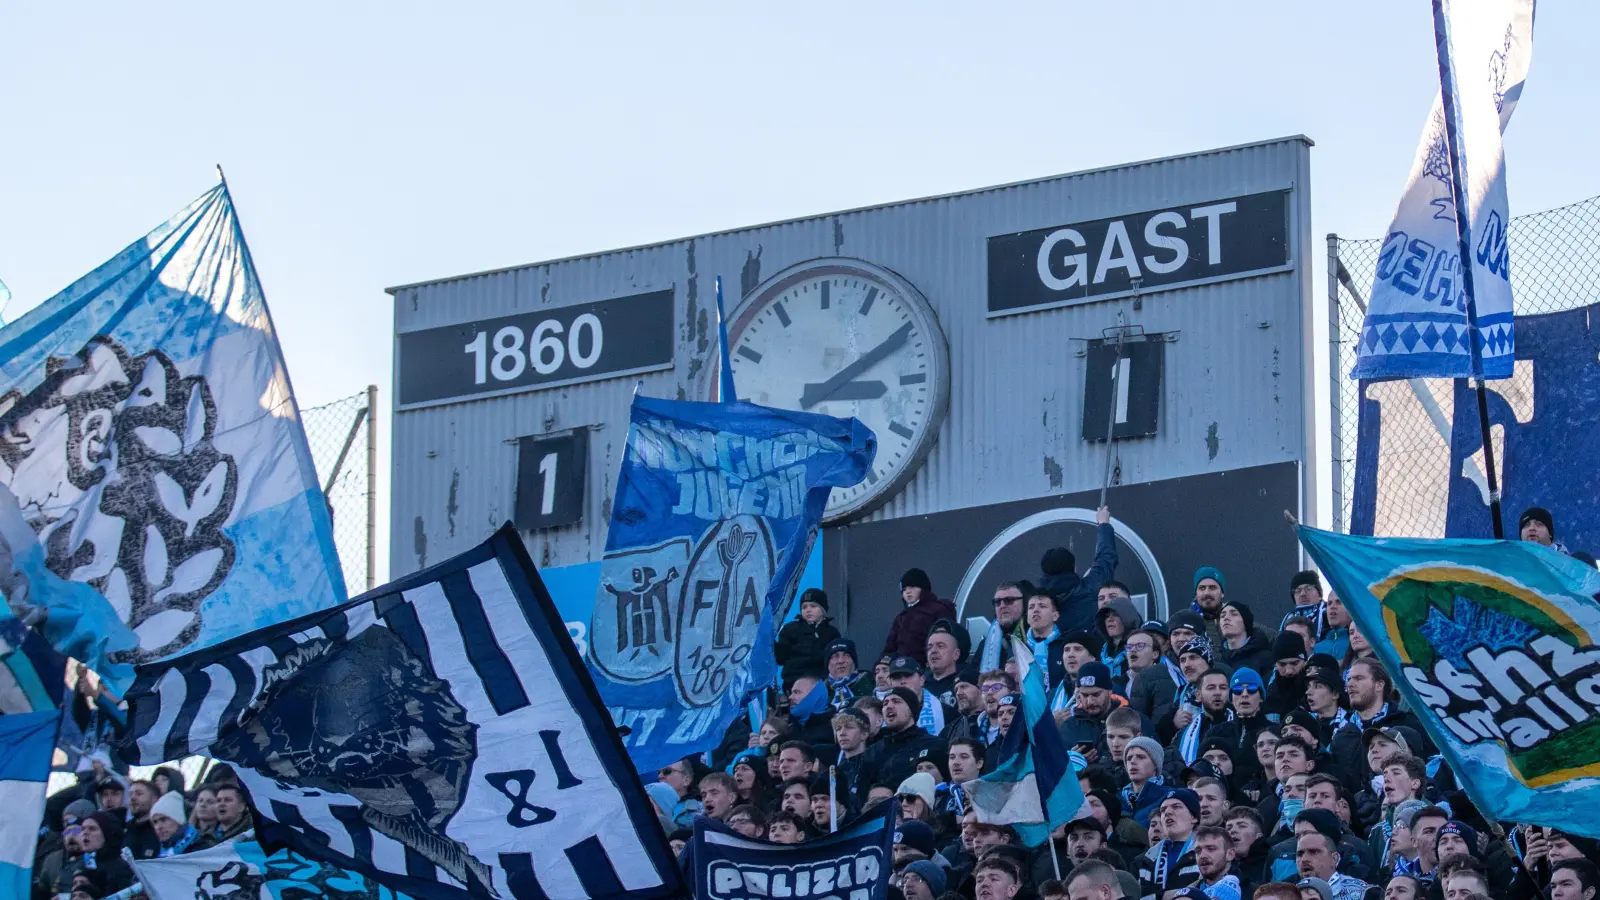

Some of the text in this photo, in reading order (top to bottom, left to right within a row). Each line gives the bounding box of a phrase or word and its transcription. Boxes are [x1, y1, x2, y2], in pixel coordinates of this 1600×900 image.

[1036, 201, 1237, 291] GAST
[464, 313, 604, 385] 1860
[1111, 357, 1131, 424] 1
[538, 452, 559, 516] 1
[672, 464, 807, 521] JUGEND
[688, 643, 750, 695] 1860
[714, 854, 880, 898] POLIZIA
